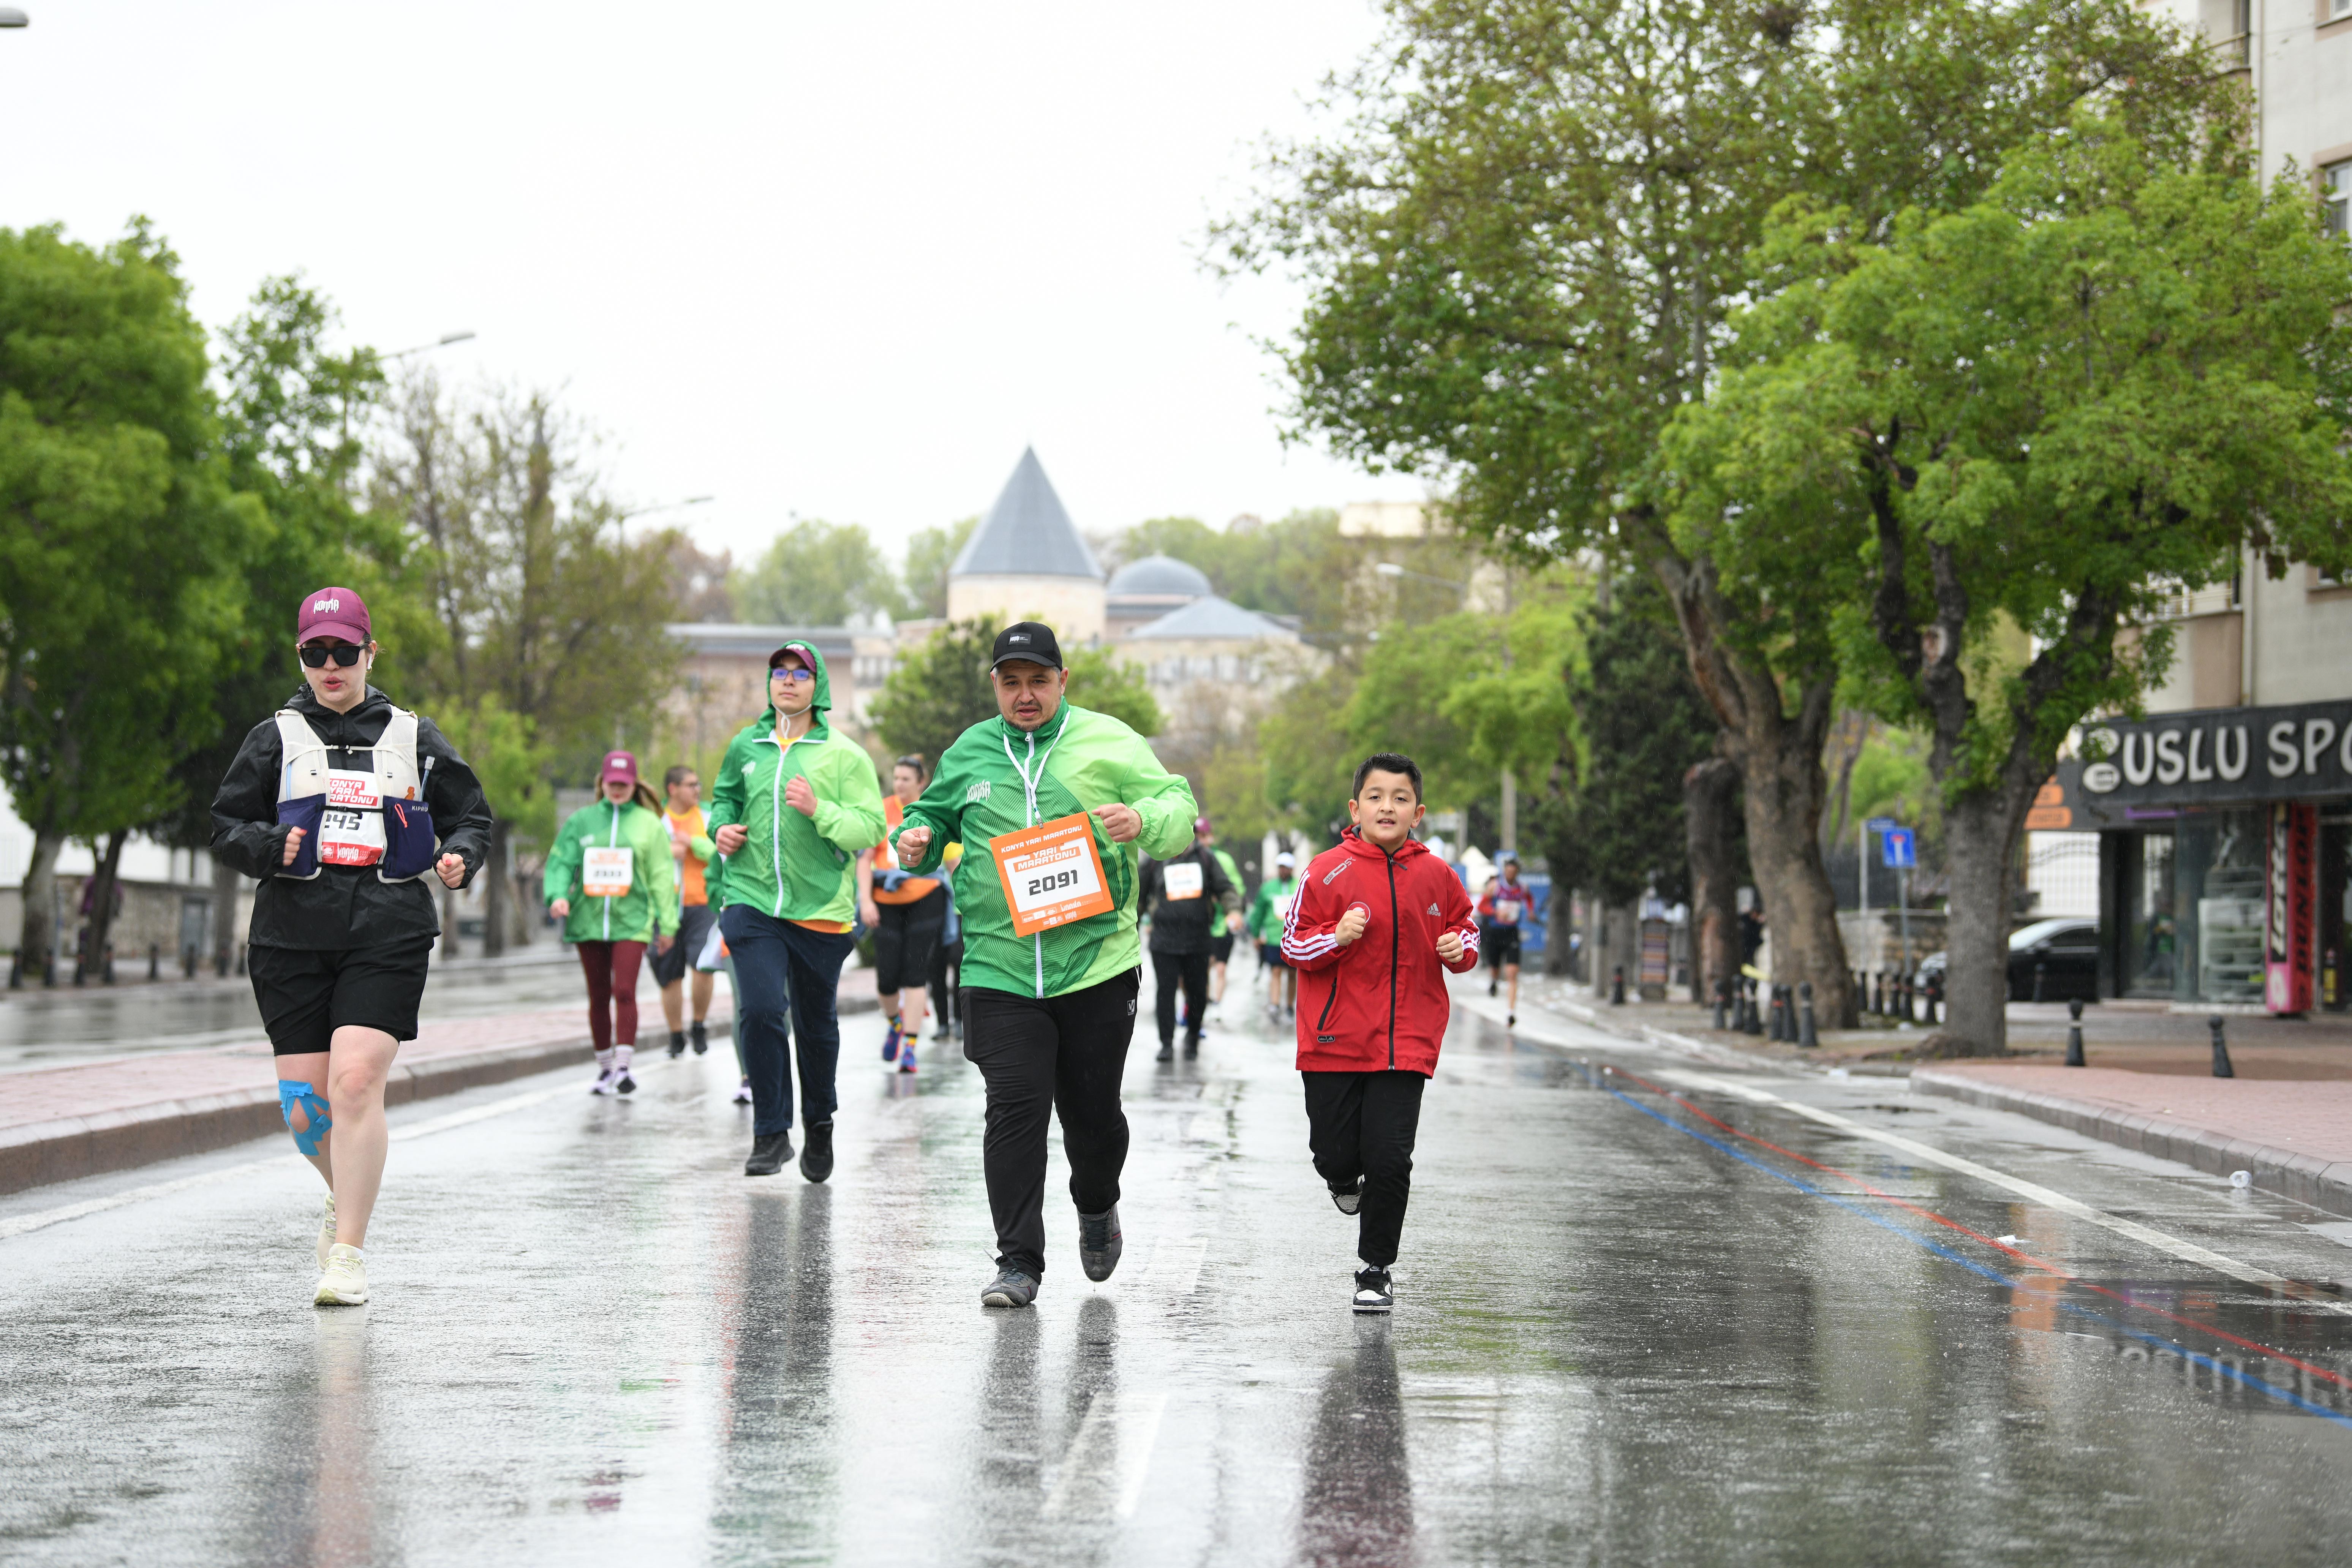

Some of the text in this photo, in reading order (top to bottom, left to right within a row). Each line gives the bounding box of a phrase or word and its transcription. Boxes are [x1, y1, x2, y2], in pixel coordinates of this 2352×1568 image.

[2123, 725, 2249, 786] USLU
[330, 794, 374, 805] RATONU
[1001, 825, 1082, 854] KONYA YARI MARATONU
[1018, 849, 1076, 870] MARATONU
[1033, 846, 1057, 858] YARI
[1029, 869, 1078, 896] 2091
